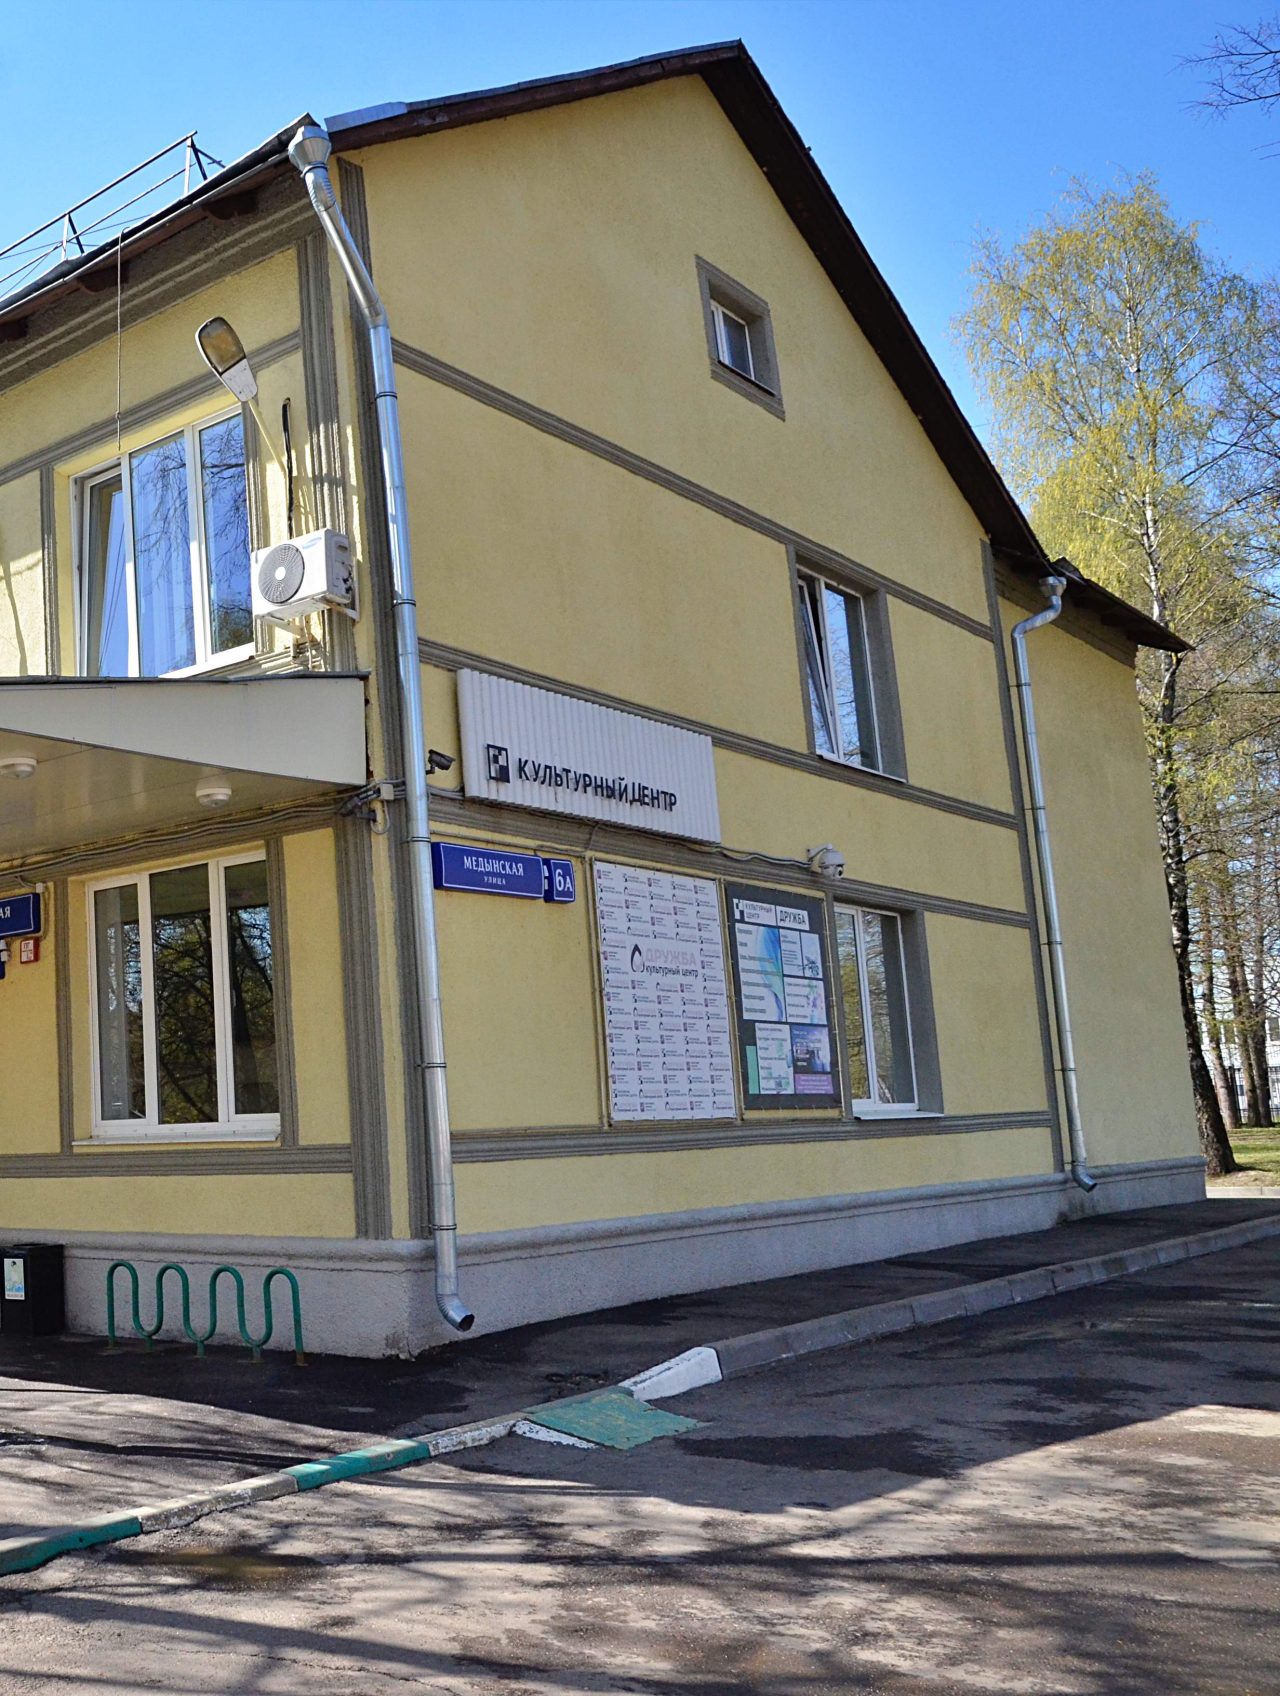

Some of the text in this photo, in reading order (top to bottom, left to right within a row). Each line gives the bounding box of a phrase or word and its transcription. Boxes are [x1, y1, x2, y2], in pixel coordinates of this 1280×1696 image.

[518, 757, 677, 812] КУЛЬТУРНЫЙ ЦЕНТР
[463, 855, 524, 877] МЕДЫНСКАЯ
[555, 868, 573, 892] 6А
[779, 910, 807, 925] ДРУЖБА
[645, 948, 697, 966] ДРУЖБА
[646, 965, 699, 979] культурный центр
